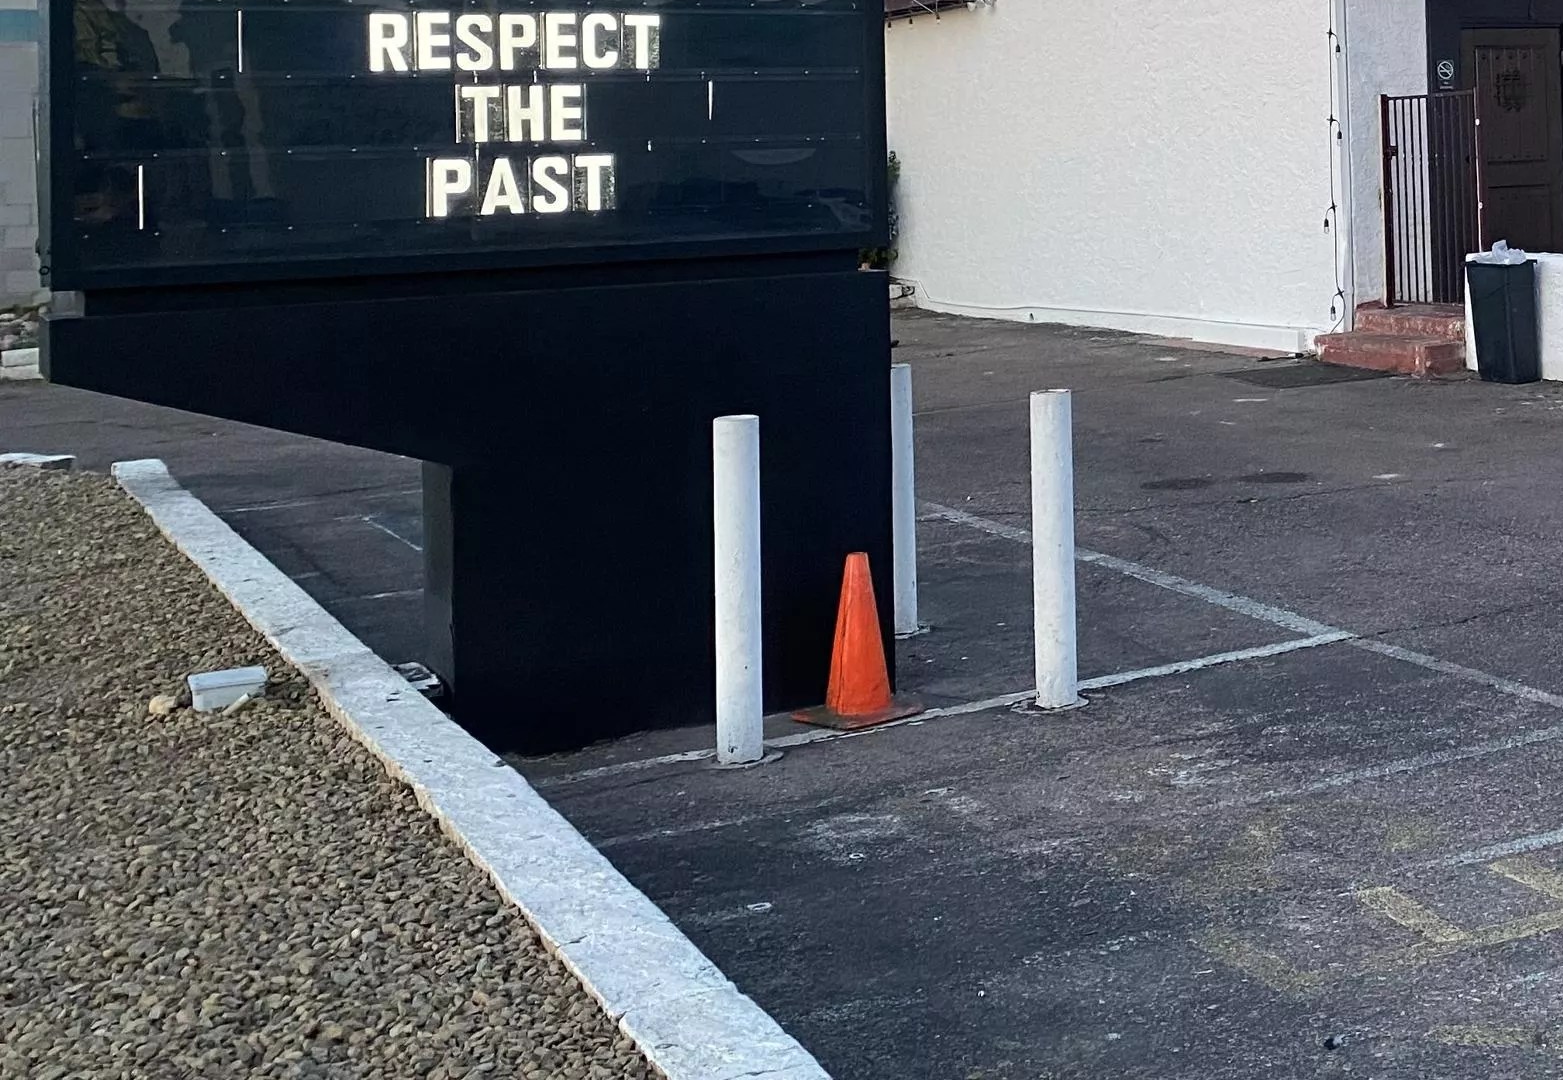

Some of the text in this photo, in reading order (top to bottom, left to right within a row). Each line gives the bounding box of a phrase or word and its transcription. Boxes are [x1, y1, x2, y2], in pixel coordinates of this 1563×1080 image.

[368, 11, 661, 73] RESPECT
[460, 84, 583, 144] THE
[432, 154, 616, 218] PAST
